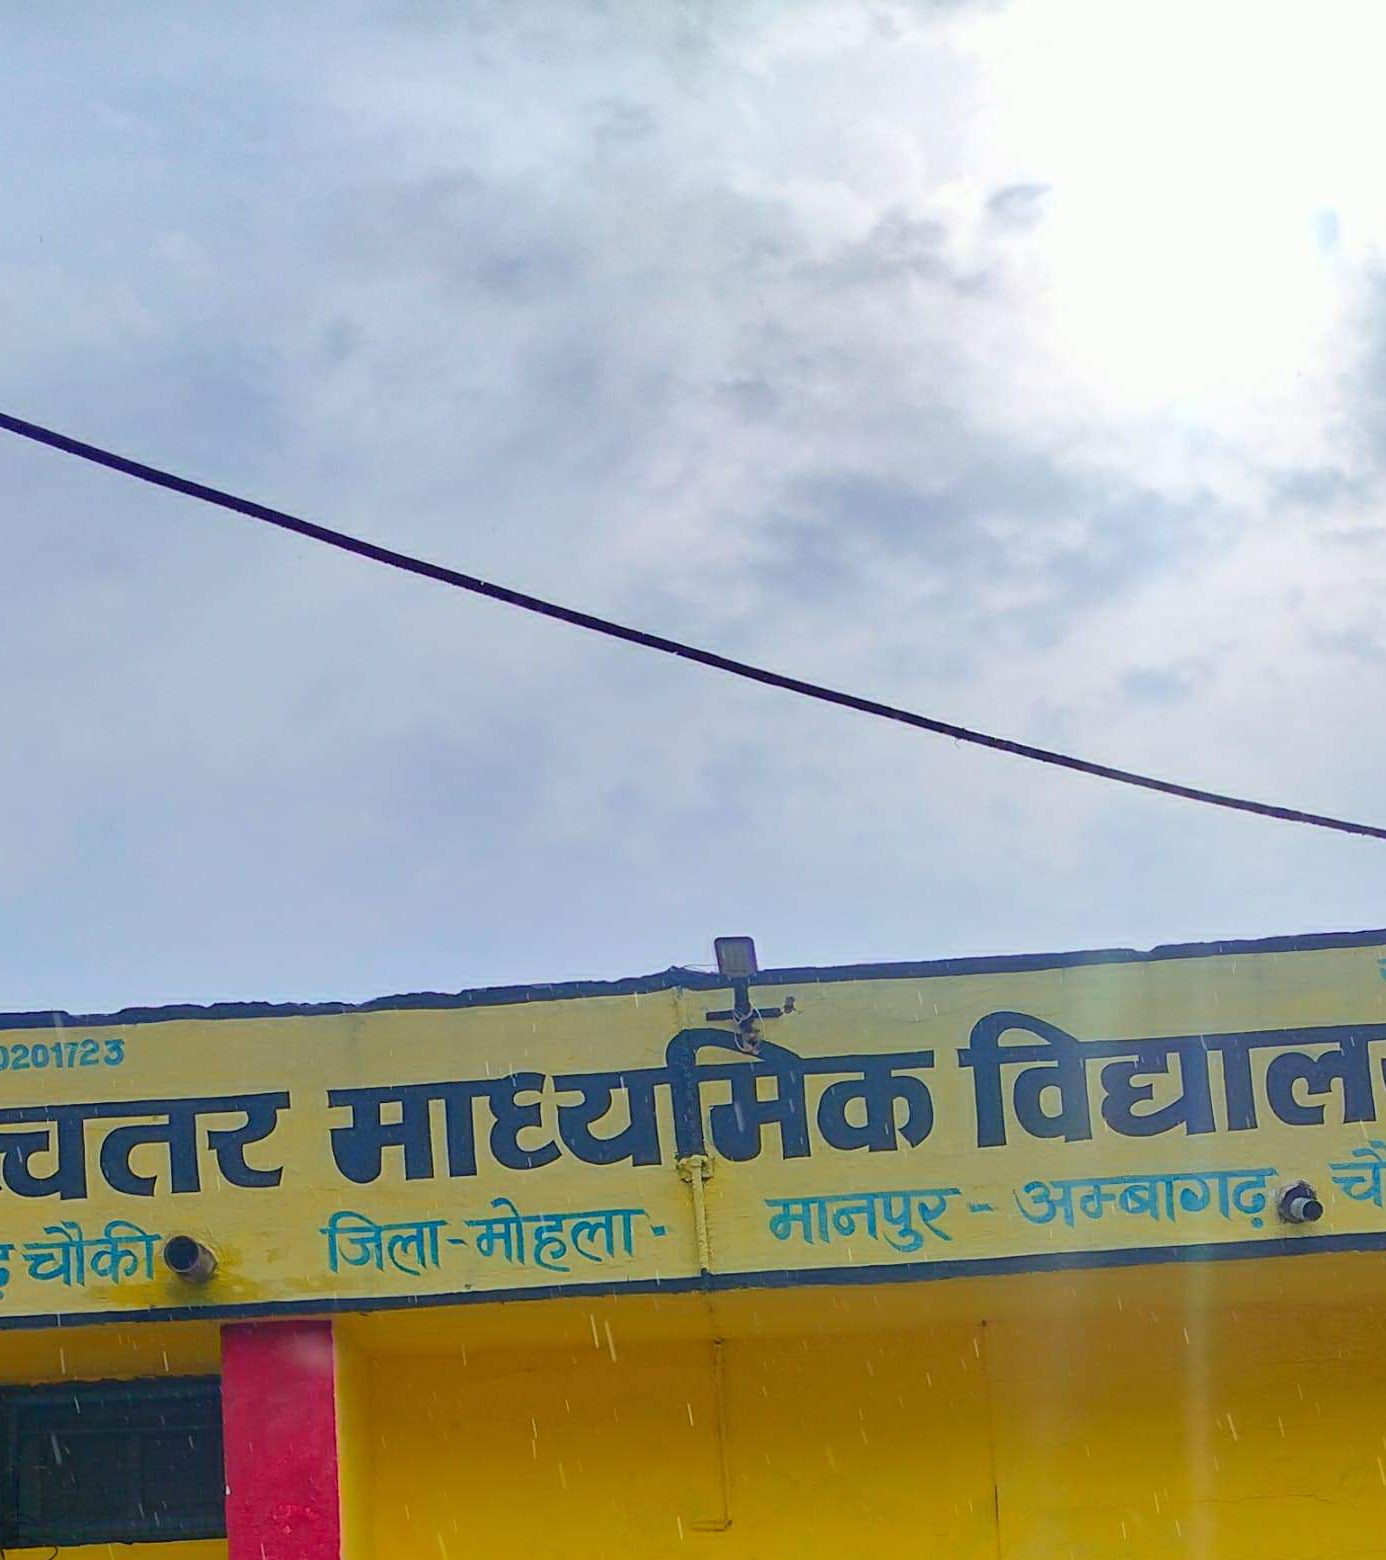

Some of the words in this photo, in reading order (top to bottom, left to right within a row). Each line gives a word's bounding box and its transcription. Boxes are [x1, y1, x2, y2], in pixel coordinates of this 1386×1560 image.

[326, 1028, 935, 1185] माध्यमिक
[21, 1220, 162, 1286] चौकी
[1013, 1166, 1279, 1229] अम्बागढ़
